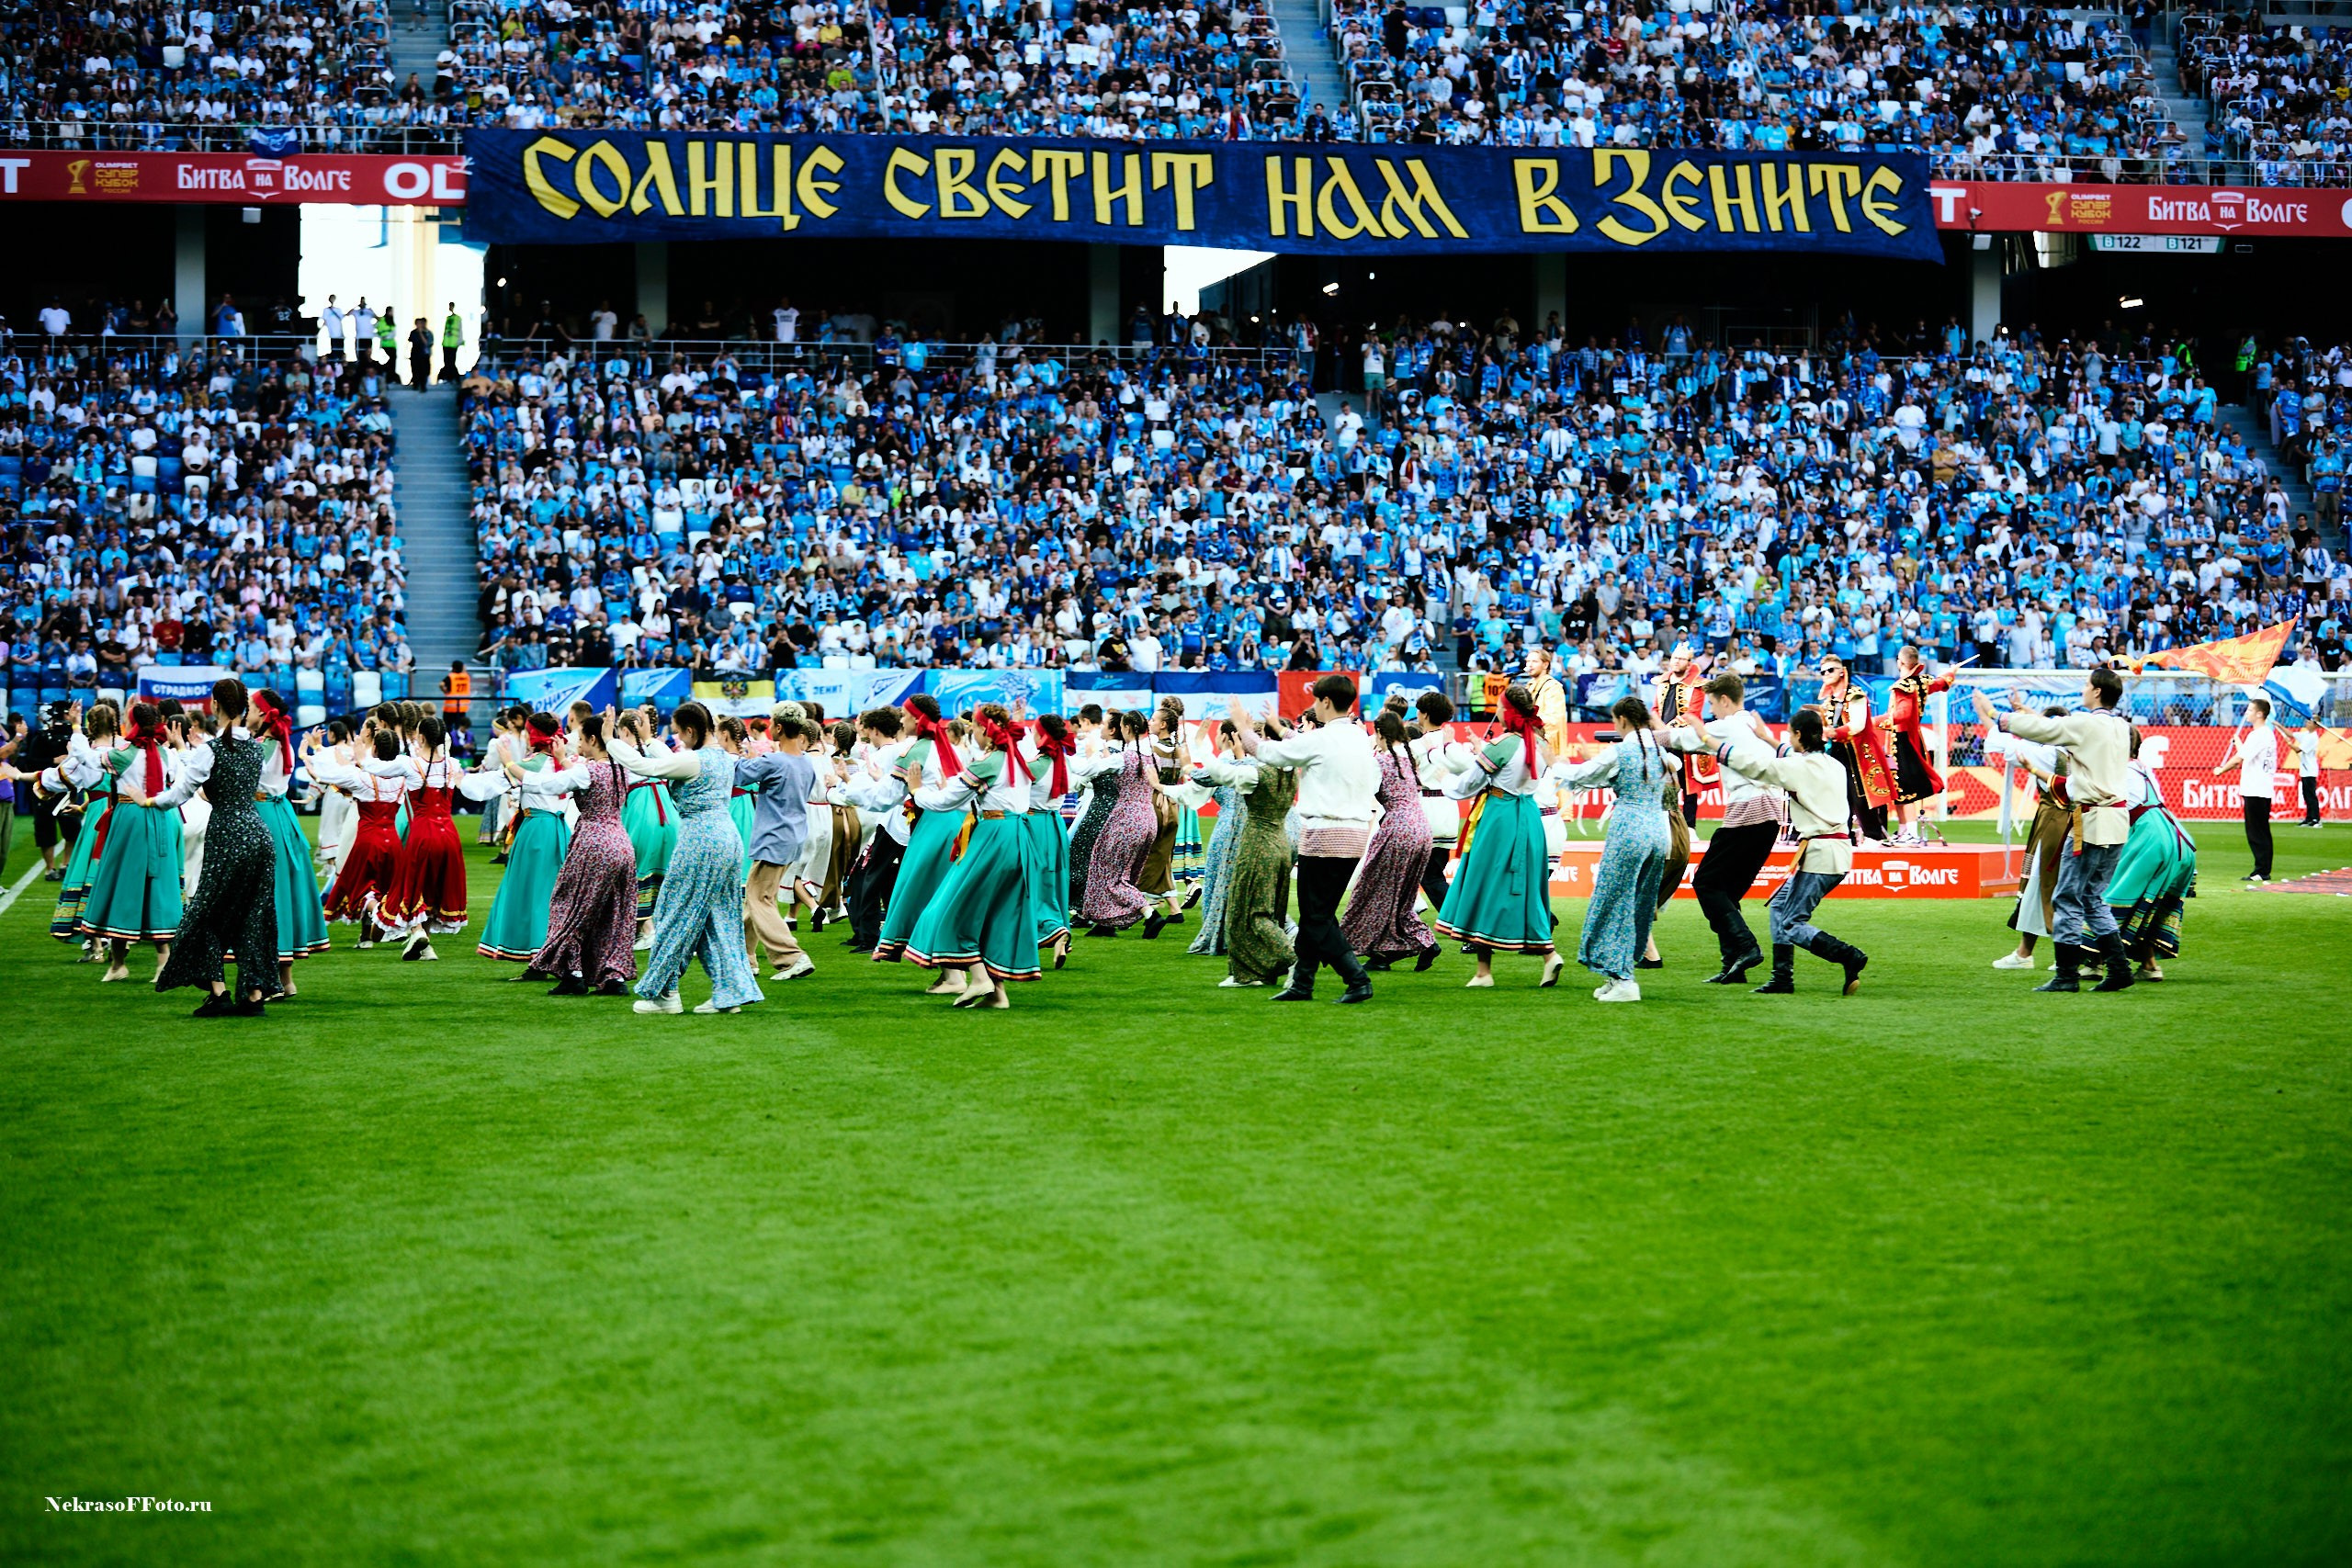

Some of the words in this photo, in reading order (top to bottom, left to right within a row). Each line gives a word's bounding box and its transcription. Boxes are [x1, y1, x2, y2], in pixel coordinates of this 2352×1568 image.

[96, 169, 139, 178] СУПЕР
[96, 178, 139, 187] КУБОК
[523, 135, 845, 231] СОЛНЦЕ
[884, 147, 1214, 231] СВЕТИТ
[1264, 155, 1470, 240] НАМ
[1513, 158, 1579, 234] В
[1594, 148, 1906, 246] ЗЕНИТЕ
[2071, 200, 2111, 209] СУПЕР
[2071, 209, 2111, 219] КУБОК
[2118, 236, 2141, 248] 122
[2181, 238, 2201, 249] 121
